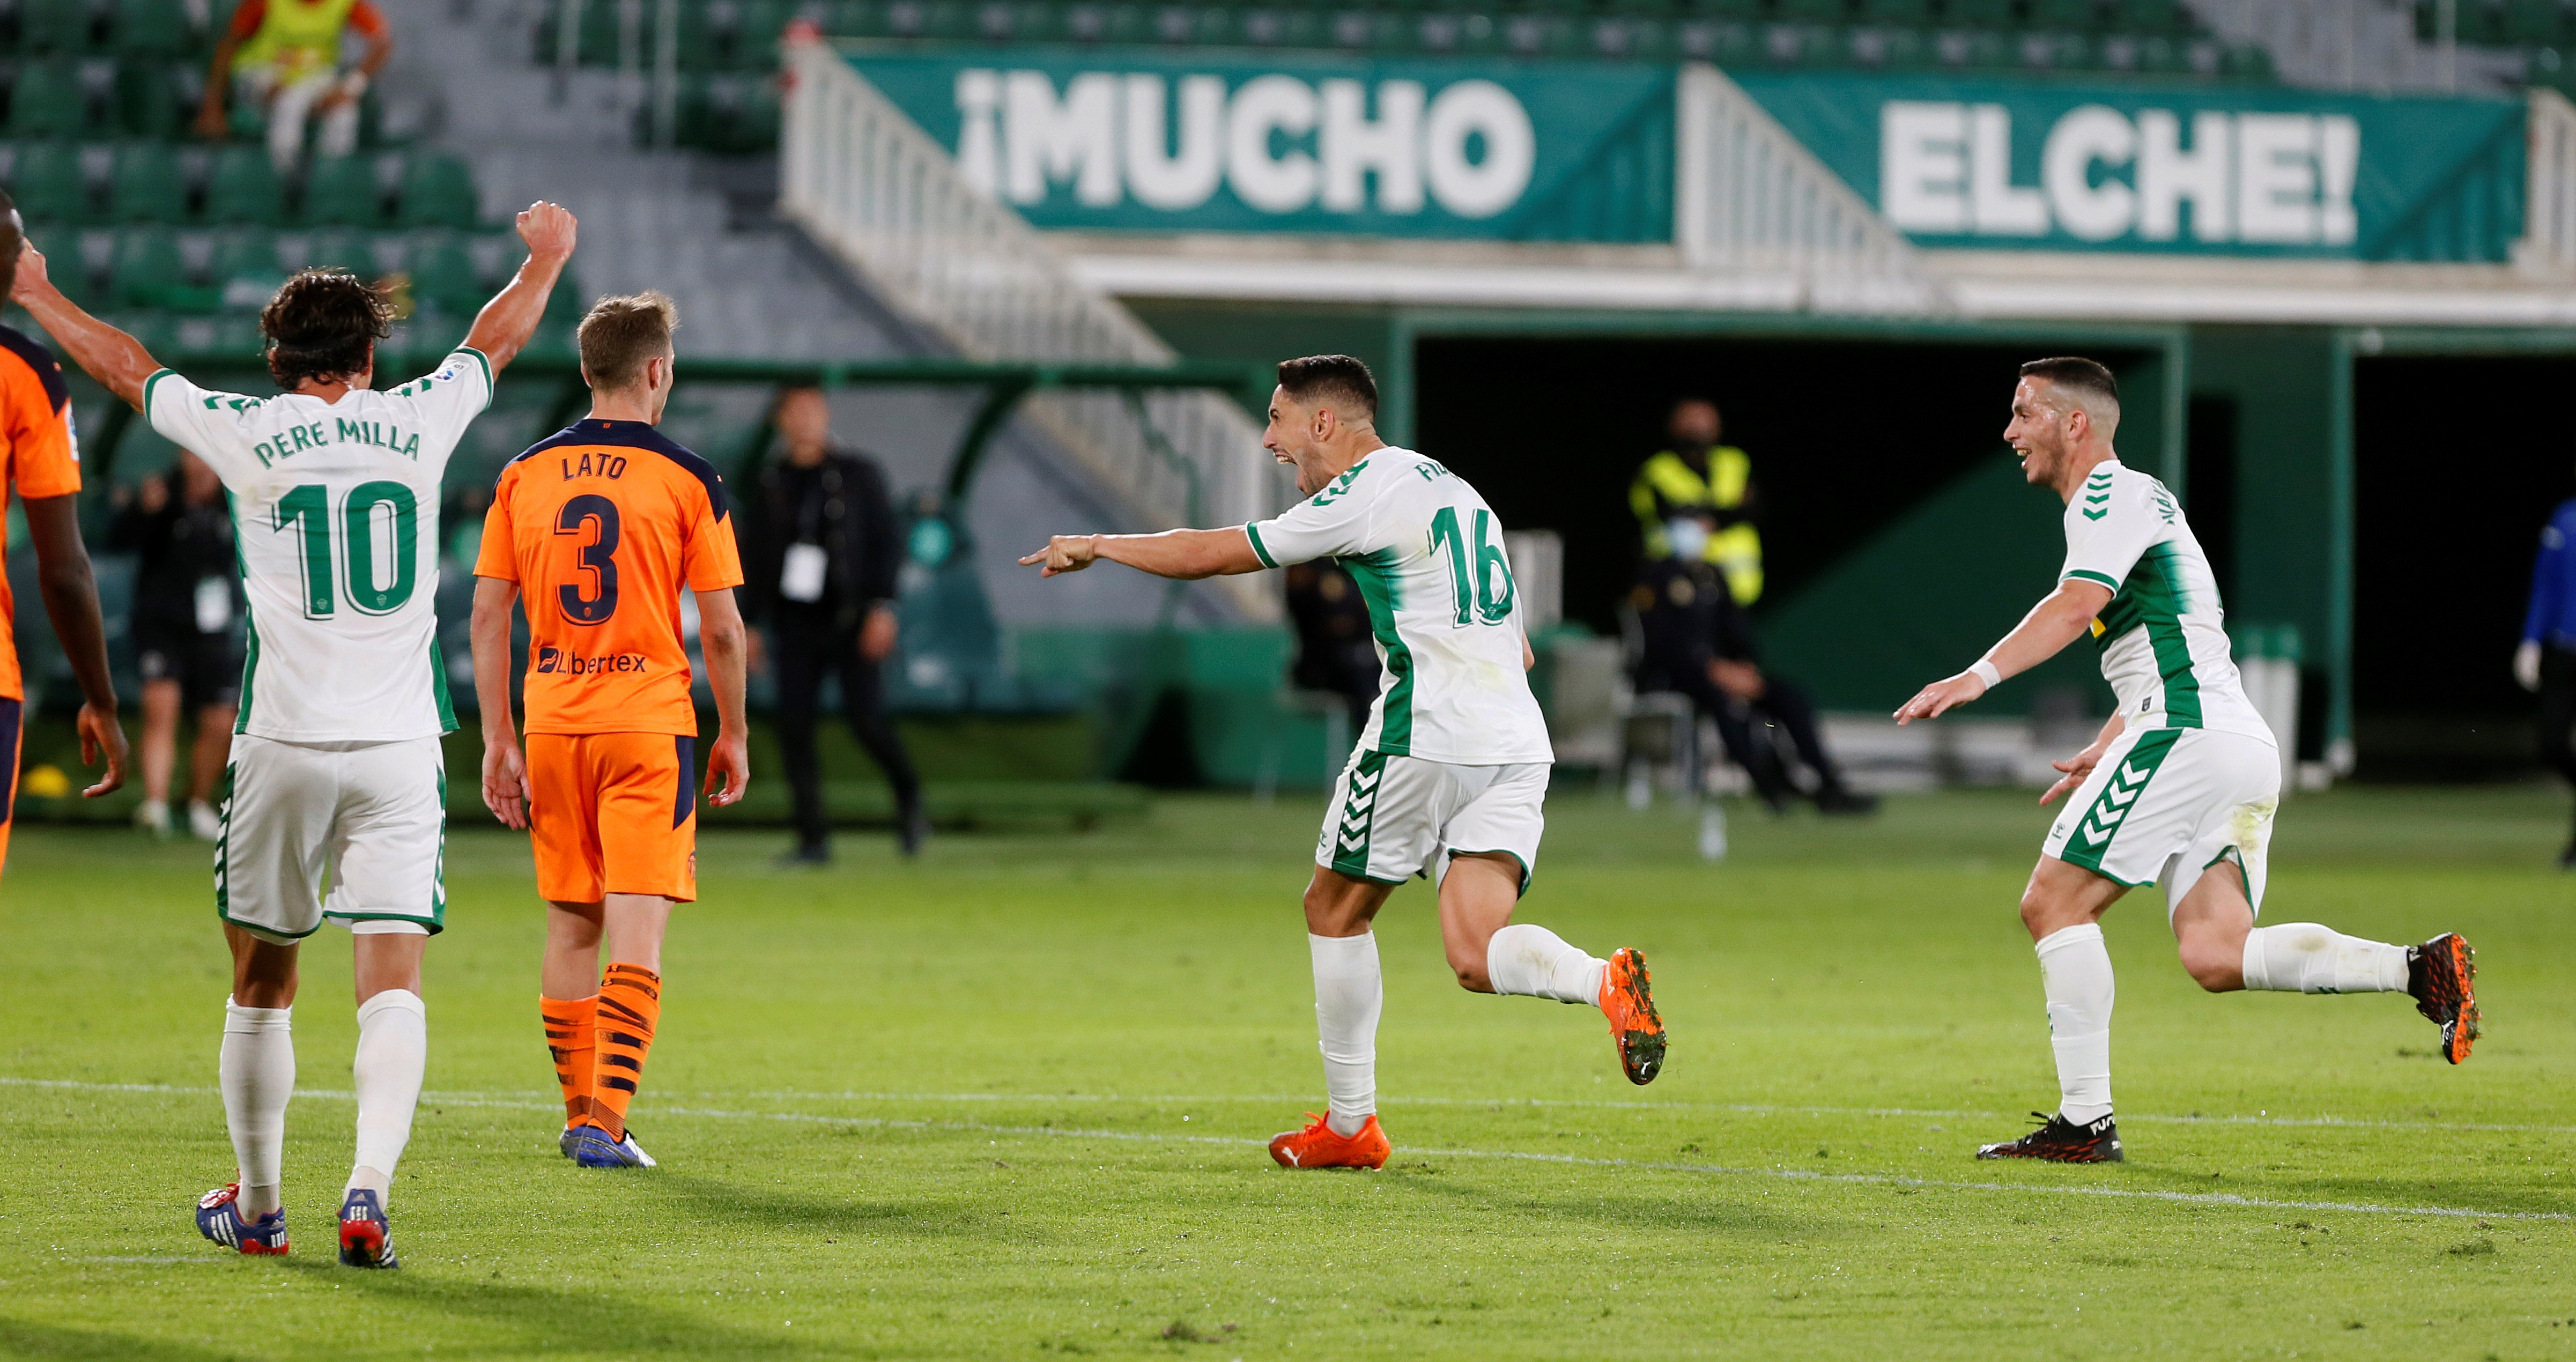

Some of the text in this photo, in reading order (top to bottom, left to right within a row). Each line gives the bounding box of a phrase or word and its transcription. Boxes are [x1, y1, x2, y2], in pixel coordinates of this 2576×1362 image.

[1880, 101, 2360, 245] ELCHE!
[254, 417, 420, 470] PERE MILLA
[561, 453, 627, 481] LATO
[271, 480, 418, 621] 10
[554, 494, 620, 627] 3
[1426, 506, 1514, 629] 16
[556, 651, 646, 675] Libertex
